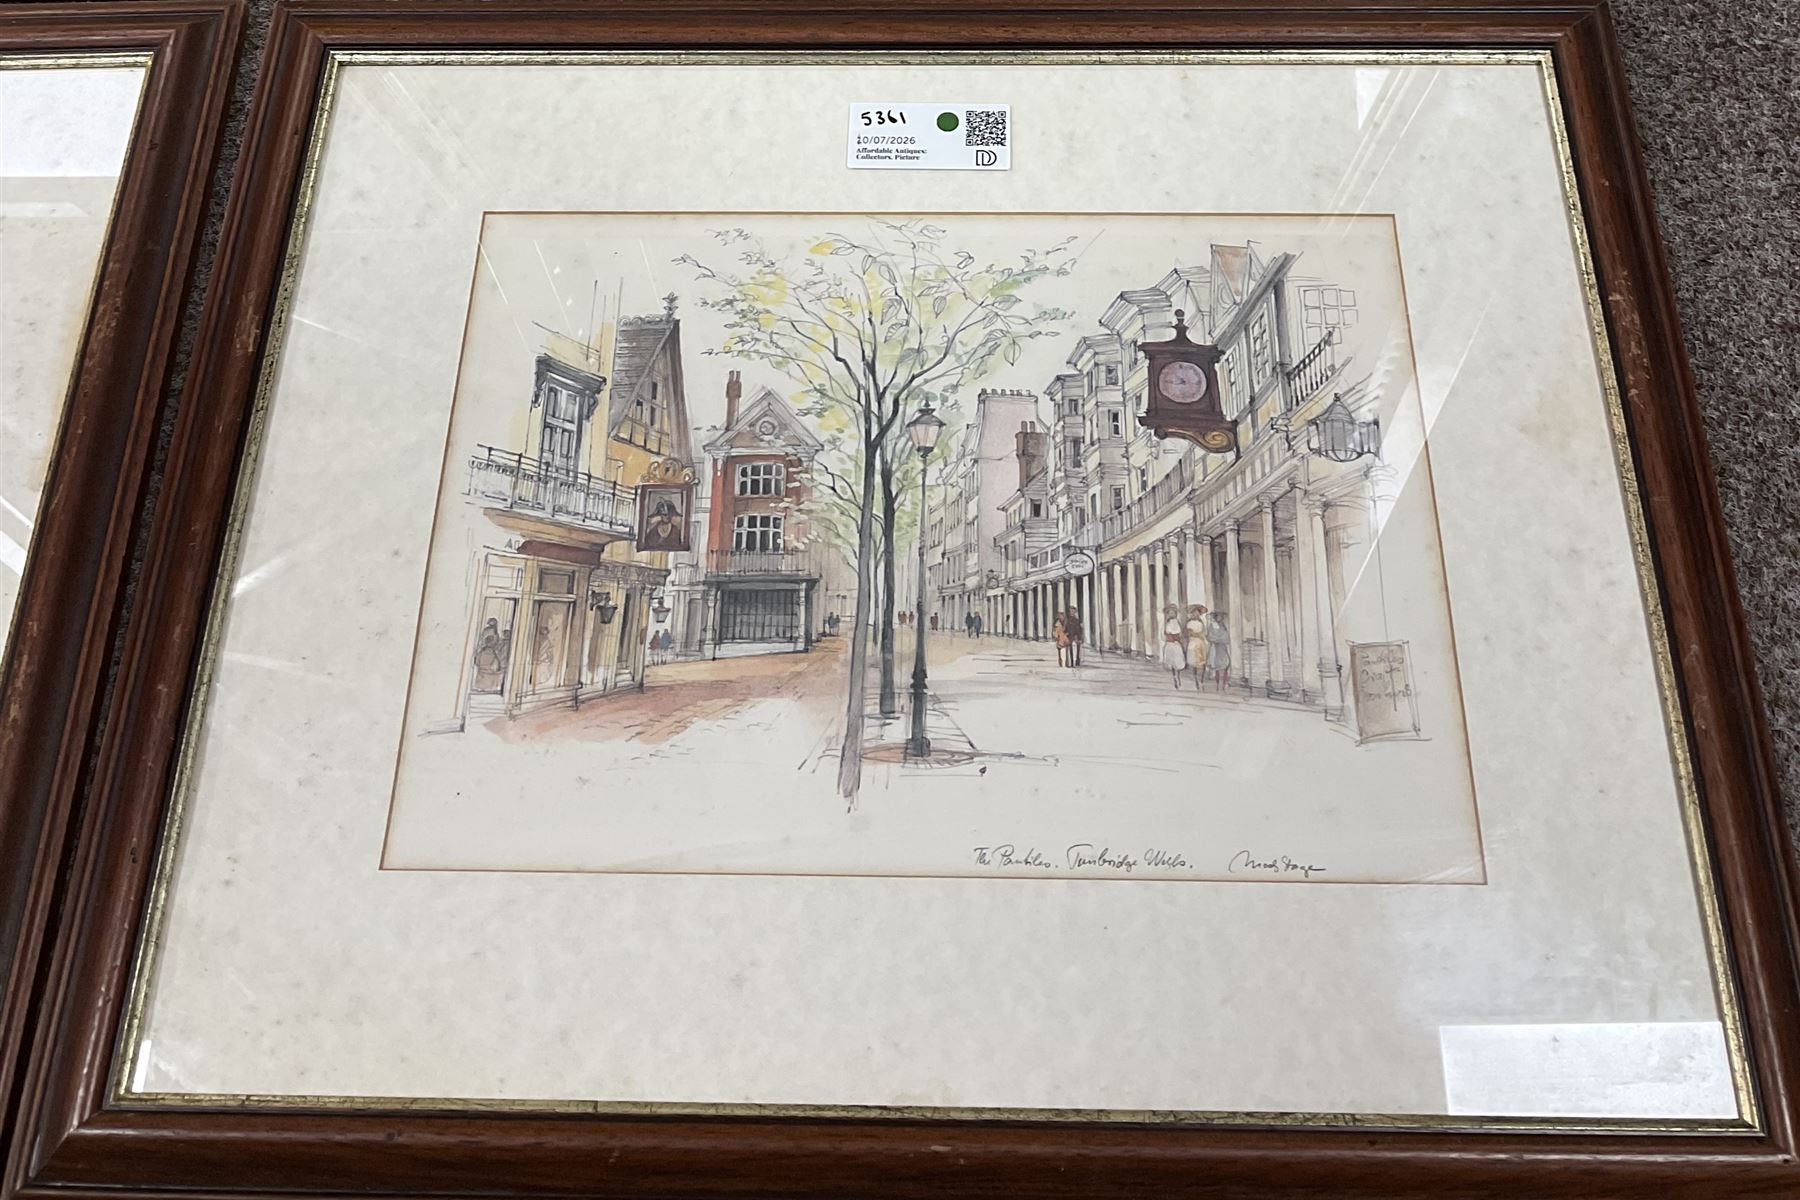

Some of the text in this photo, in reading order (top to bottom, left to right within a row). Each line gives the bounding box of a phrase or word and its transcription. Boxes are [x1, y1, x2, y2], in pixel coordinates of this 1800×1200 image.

[861, 110, 906, 126] 5361
[857, 136, 916, 145] 10/07/2026
[895, 147, 928, 155] Antiques:
[973, 847, 991, 866] The
[1066, 843, 1138, 872] Tunbridge
